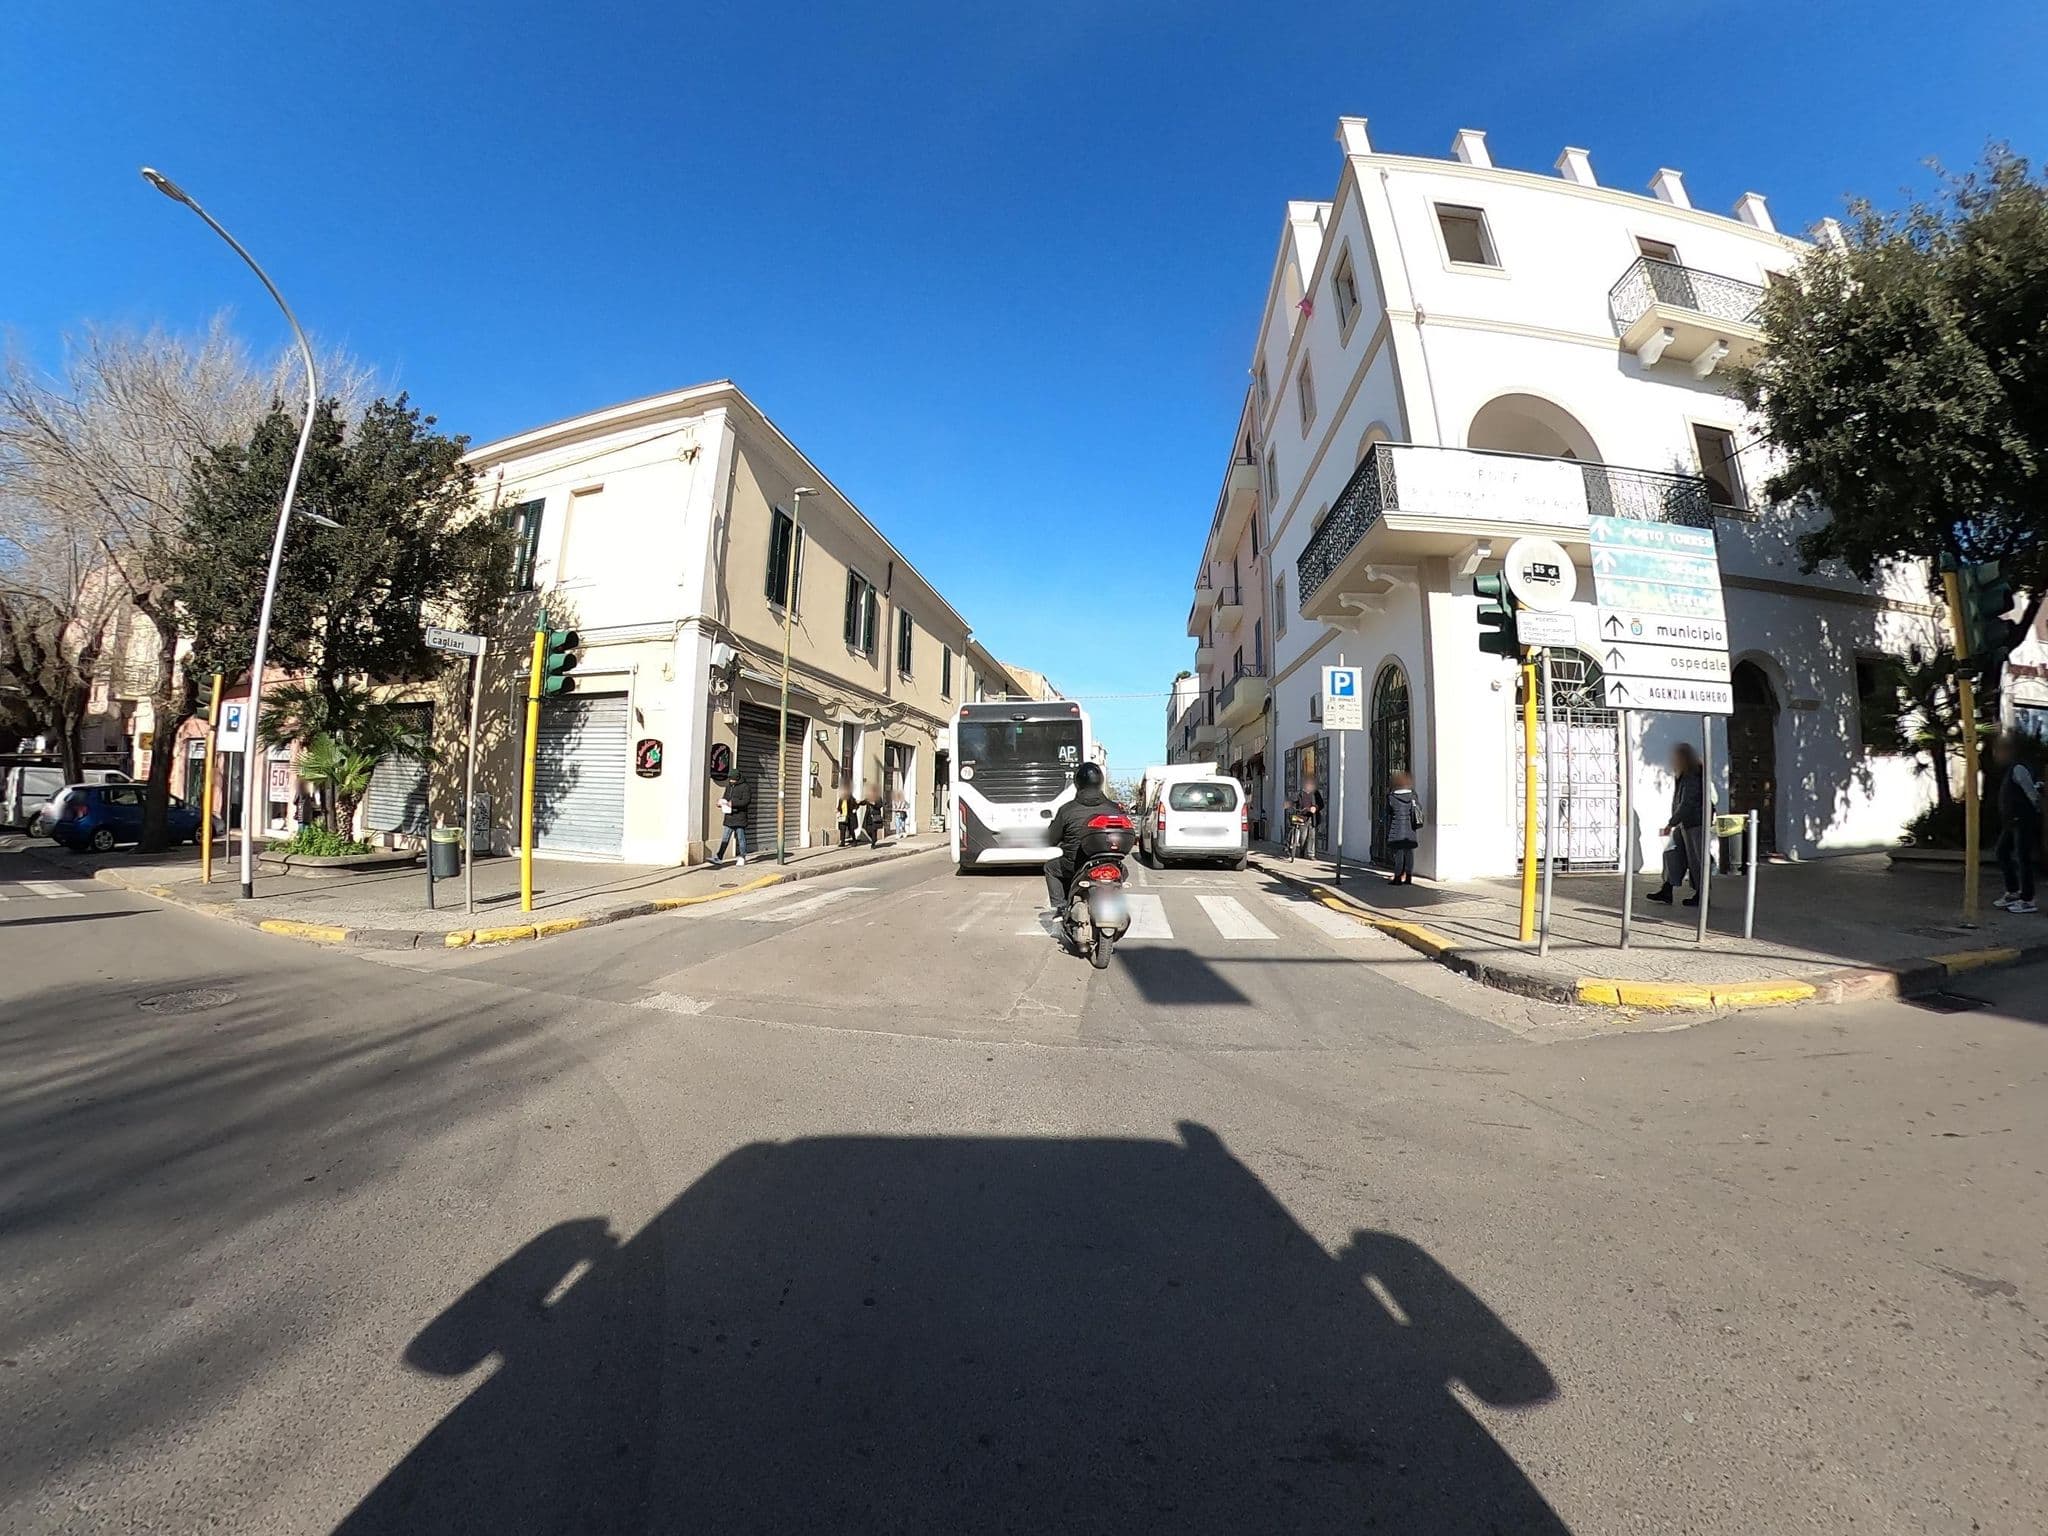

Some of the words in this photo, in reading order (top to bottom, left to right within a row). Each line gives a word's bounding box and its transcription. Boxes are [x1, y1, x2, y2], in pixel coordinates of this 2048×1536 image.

[1623, 527, 1665, 542] PORTO
[1667, 532, 1714, 547] TORRES
[1534, 564, 1545, 574] 35
[1657, 625, 1723, 642] municipio
[432, 637, 465, 649] cagliari
[1670, 657, 1728, 672] ospedale
[1334, 672, 1351, 694] P
[1649, 687, 1687, 700] AGENZIA
[1689, 689, 1728, 703] ALGHERO
[1058, 745, 1076, 760] AP
